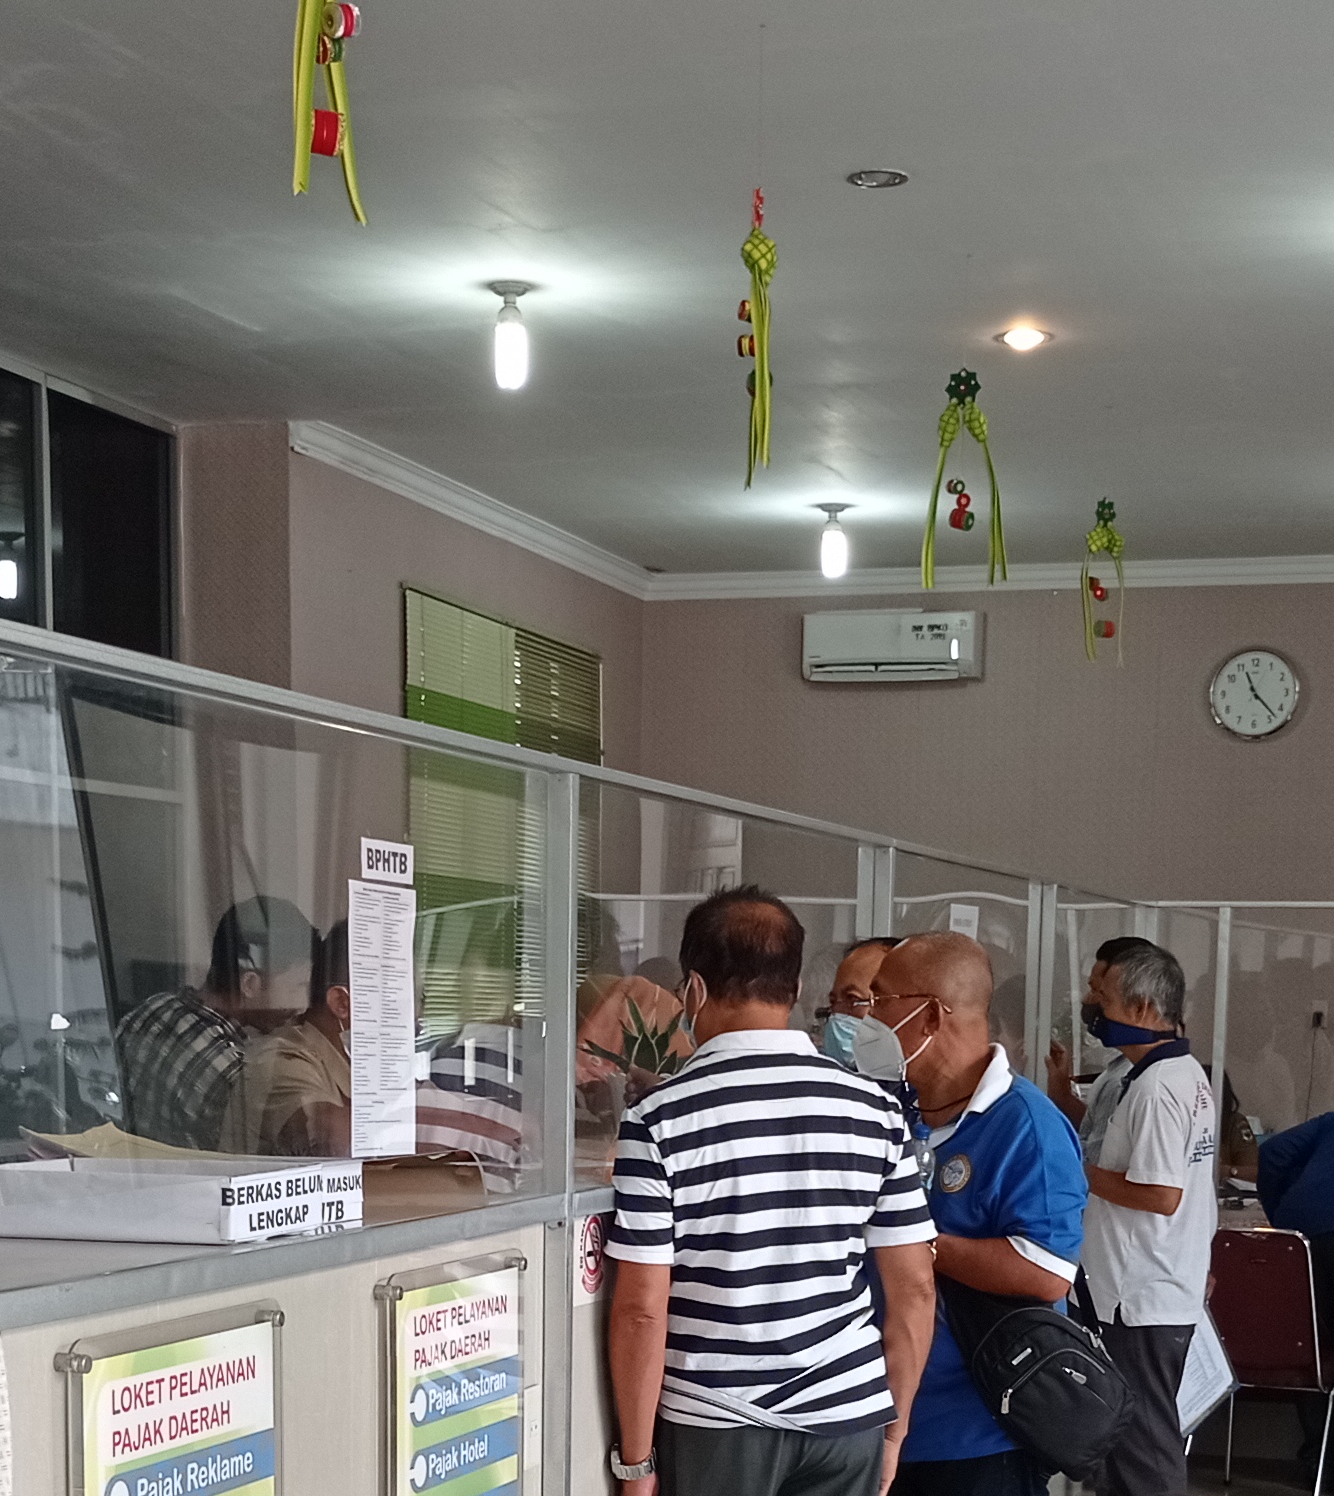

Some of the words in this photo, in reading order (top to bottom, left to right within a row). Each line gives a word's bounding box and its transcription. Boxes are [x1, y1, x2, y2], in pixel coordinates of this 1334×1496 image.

[366, 847, 408, 874] BPHTB
[221, 1180, 282, 1206] BERKAS
[327, 1174, 362, 1194] MASUK
[249, 1204, 309, 1232] LENGKAP
[414, 1308, 449, 1337] LOKET
[450, 1294, 508, 1326] PELAYANAN
[414, 1340, 447, 1371] PAJAK
[450, 1329, 491, 1361] DAERAH
[111, 1378, 165, 1415] LOKET
[169, 1355, 256, 1401] PELAYANAN
[428, 1384, 459, 1415] Pajak
[461, 1371, 506, 1405] Restoran
[112, 1418, 164, 1457] PAJAK
[169, 1400, 231, 1441] DAERAH
[187, 1451, 254, 1493] Reklame
[428, 1448, 459, 1479] Pajak
[460, 1434, 488, 1465] Hotel
